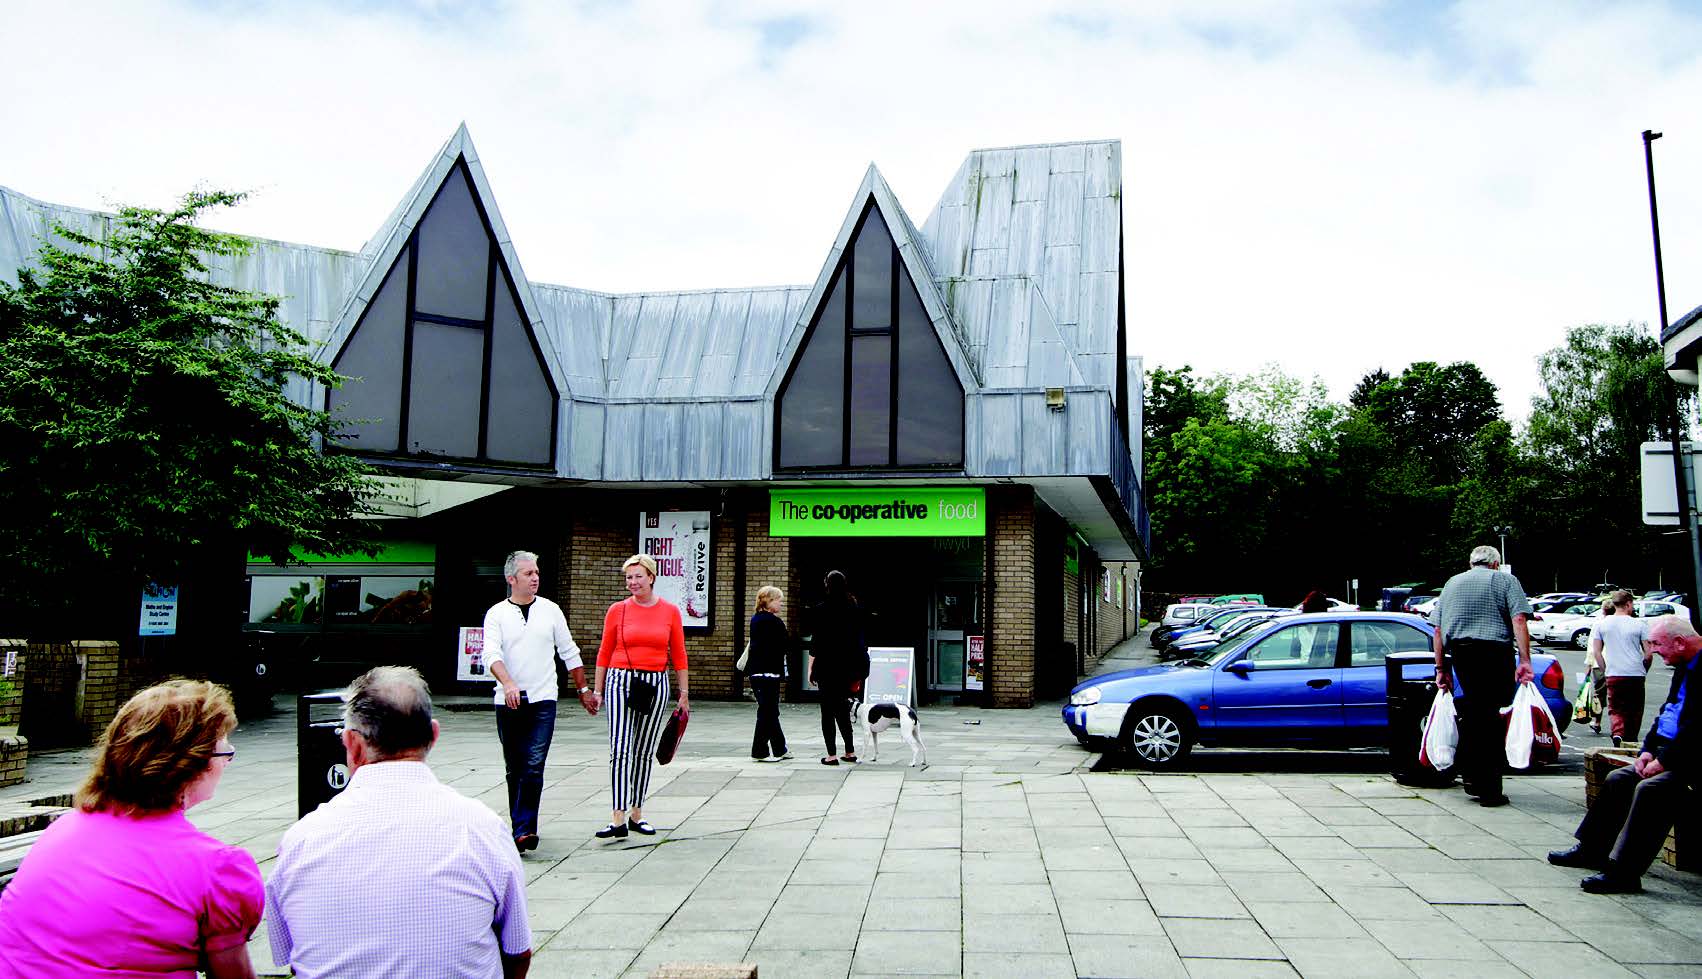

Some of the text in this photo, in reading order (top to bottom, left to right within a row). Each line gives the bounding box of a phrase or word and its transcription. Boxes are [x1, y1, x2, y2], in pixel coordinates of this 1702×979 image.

[647, 517, 657, 526] YES
[779, 500, 978, 524] The co-operative food
[644, 537, 674, 556] FIGHT
[655, 558, 684, 577] TIGUE
[695, 541, 706, 592] Revive
[467, 632, 484, 641] HAL
